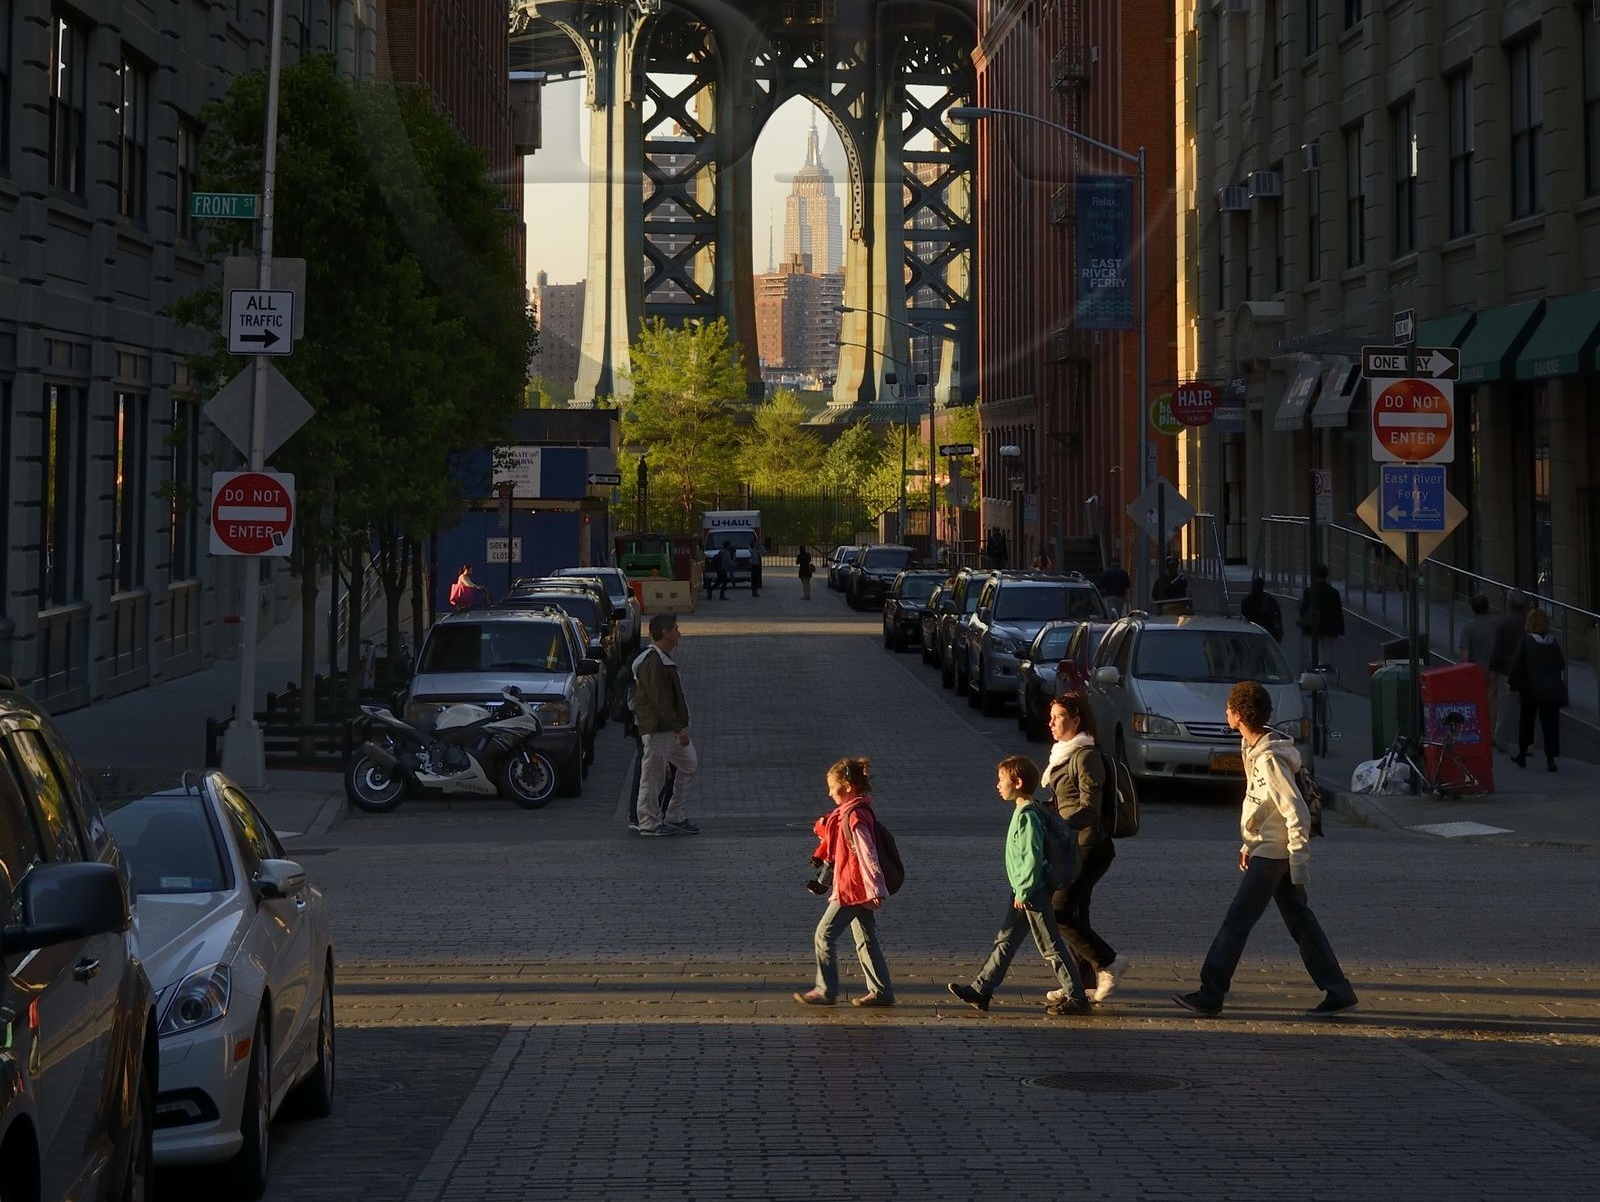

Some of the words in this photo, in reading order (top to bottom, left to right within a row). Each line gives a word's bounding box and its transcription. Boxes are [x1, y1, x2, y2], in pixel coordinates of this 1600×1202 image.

[194, 196, 238, 215] FRONT
[244, 198, 254, 207] ST
[1091, 258, 1122, 269] EAST
[1082, 268, 1117, 278] RIVER
[1090, 278, 1127, 288] FERRY
[246, 295, 277, 311] ALL
[240, 314, 283, 327] TRAFFIC
[1373, 356, 1399, 369] ONE
[1405, 357, 1431, 370] AY
[1177, 389, 1213, 407] HAIR
[1385, 395, 1404, 408] DO
[1413, 396, 1441, 409] NOT
[1390, 431, 1436, 445] ENTER
[1384, 473, 1408, 484] East
[1412, 473, 1442, 484] River
[225, 489, 244, 502] DO
[253, 490, 281, 503] NOT
[1398, 489, 1429, 501] Ferry
[229, 525, 274, 538] ENTER
[455, 781, 489, 792] SUZUKI
